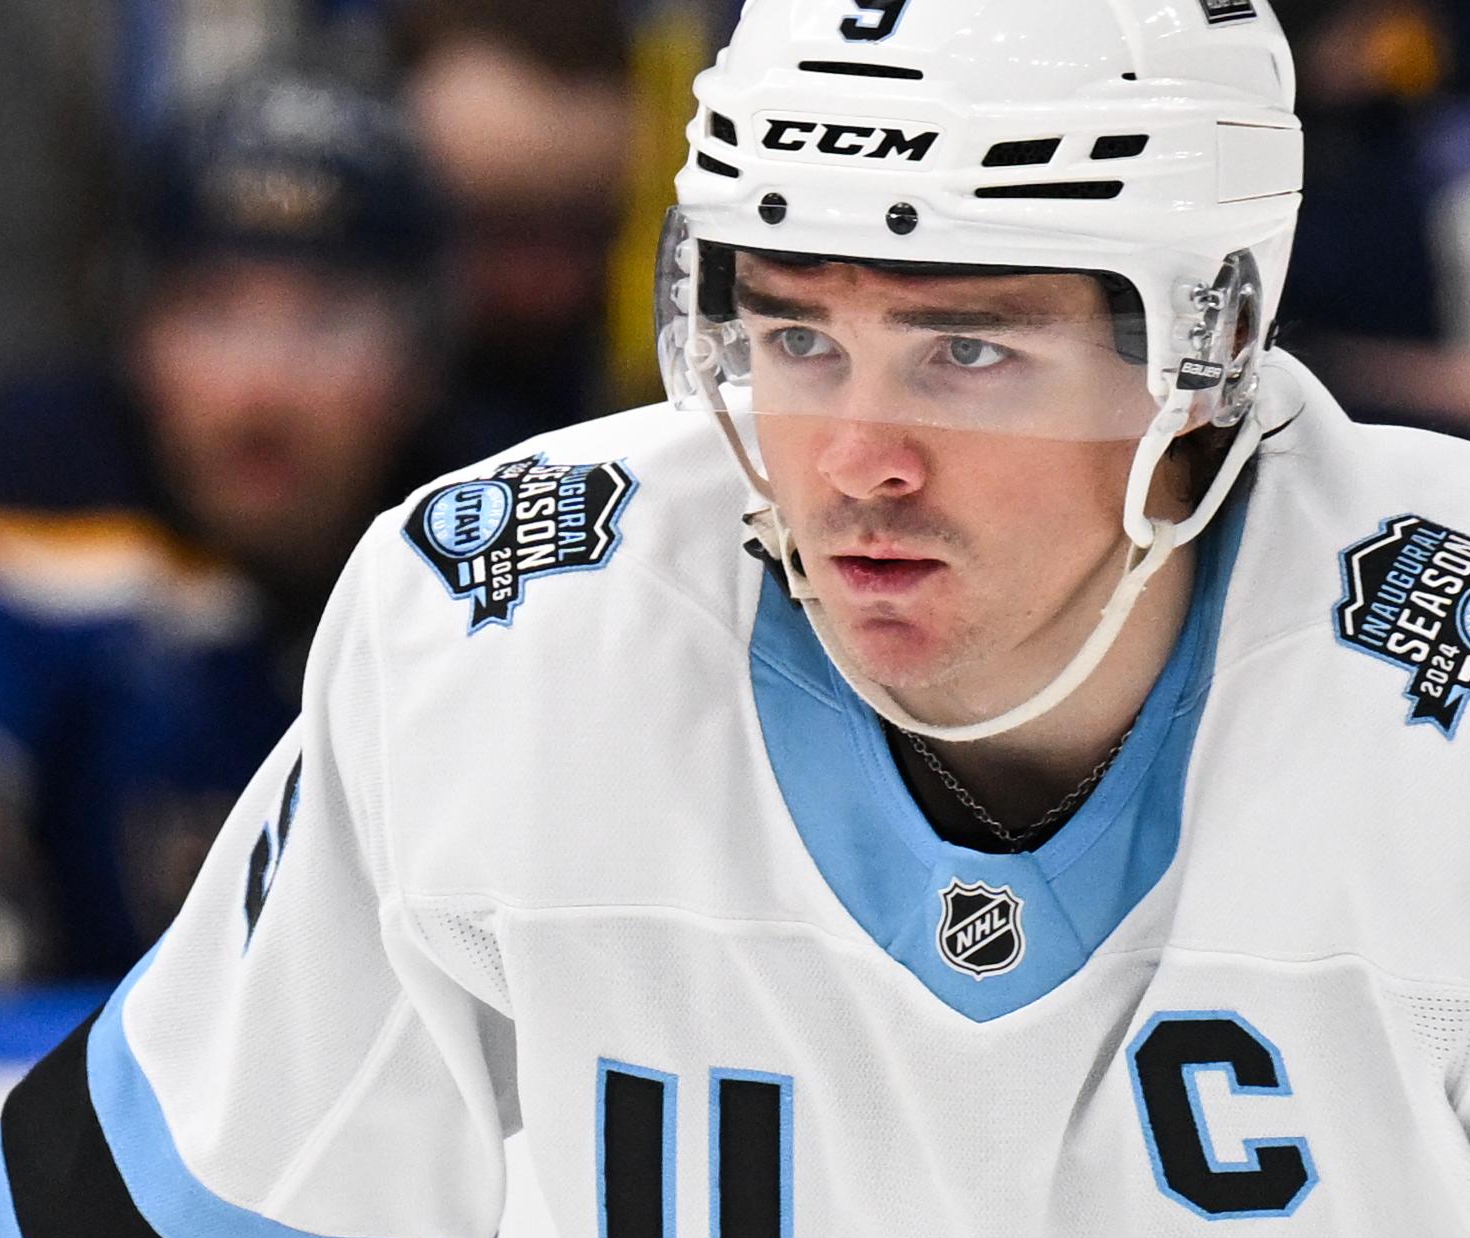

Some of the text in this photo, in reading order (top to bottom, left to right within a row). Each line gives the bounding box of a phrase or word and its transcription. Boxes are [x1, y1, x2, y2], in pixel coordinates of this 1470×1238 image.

[761, 118, 940, 163] CCM
[454, 488, 484, 546] UTAH
[516, 466, 571, 570] SEASON
[490, 547, 512, 601] 2025
[1358, 527, 1447, 646] INAUGURAL
[1420, 643, 1461, 698] 2024
[955, 913, 1008, 954] NHL
[1125, 1010, 1320, 1222] C
